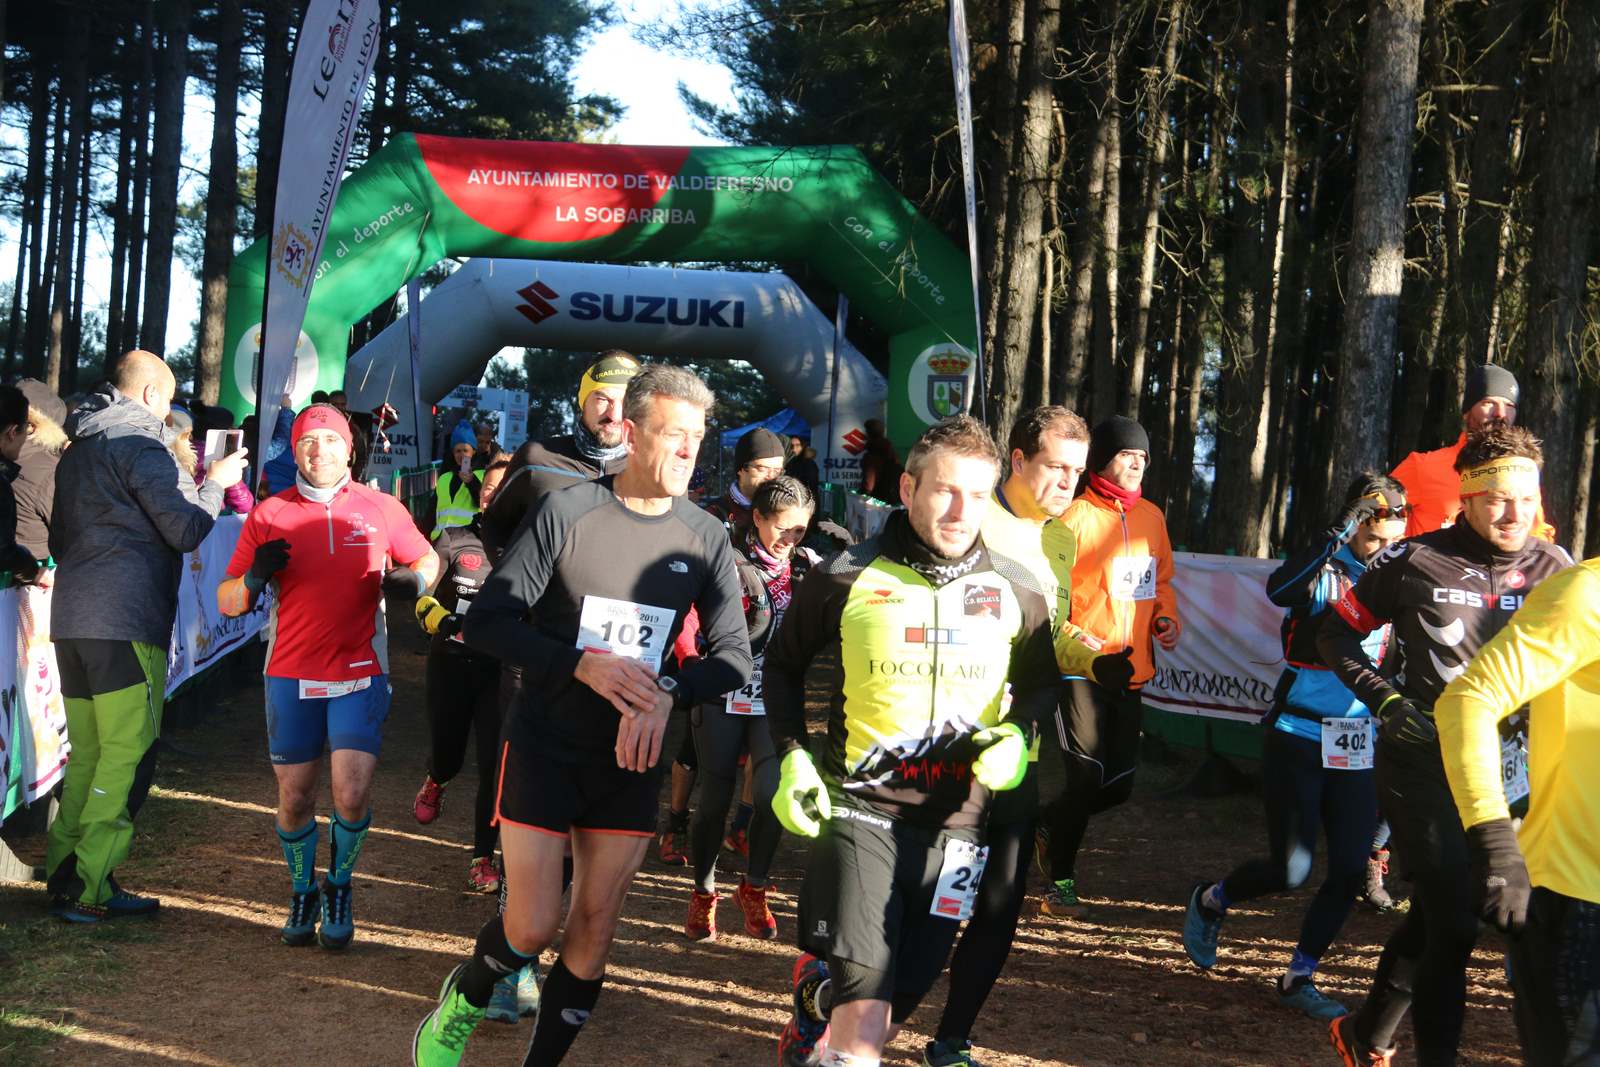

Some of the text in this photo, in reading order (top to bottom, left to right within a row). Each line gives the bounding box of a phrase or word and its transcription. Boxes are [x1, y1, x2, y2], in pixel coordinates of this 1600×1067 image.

[311, 100, 353, 238] AYUNTAMIENTO
[350, 72, 360, 94] DE
[467, 169, 794, 193] AYUNTAMIENTO DE VALDEFRESNO
[556, 206, 696, 225] LA SOBARRIBA
[843, 216, 873, 240] Con
[314, 201, 414, 280] on el deporte
[569, 291, 745, 329] SUZUKI
[1124, 569, 1152, 585] 419
[601, 620, 653, 649] 102
[1334, 732, 1366, 751] 402
